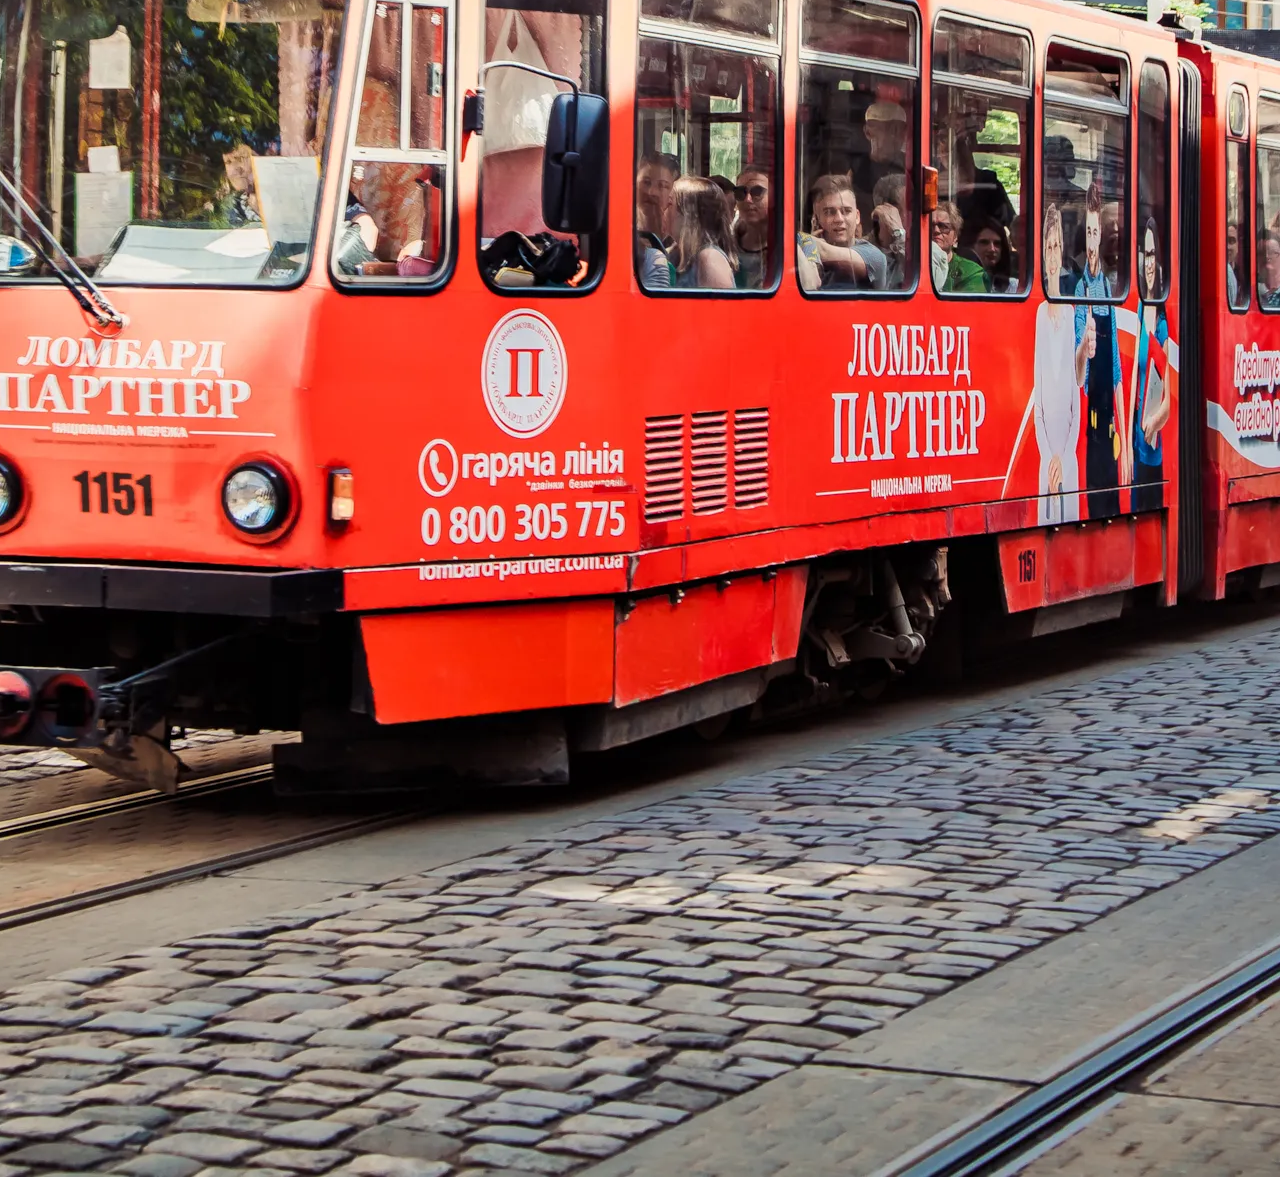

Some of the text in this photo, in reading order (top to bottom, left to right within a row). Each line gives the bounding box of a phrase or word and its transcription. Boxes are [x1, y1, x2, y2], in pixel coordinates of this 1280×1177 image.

[17, 336, 227, 378] ЛОМБАРД
[504, 348, 544, 397] П
[847, 323, 972, 386] ЛОМБАРД
[51, 422, 189, 438] НАЦІОНАЛЬНА МЕРЕЖА
[831, 390, 986, 464] ПАРТНЕР
[1234, 392, 1272, 437] вигідно
[462, 442, 624, 486] гаряча лінія
[870, 473, 952, 499] НАЦІОНАЛЬНА МЕРЕЖА
[74, 470, 154, 516] 1151
[421, 500, 626, 546] 0 800 305 775
[1018, 549, 1036, 582] 1151
